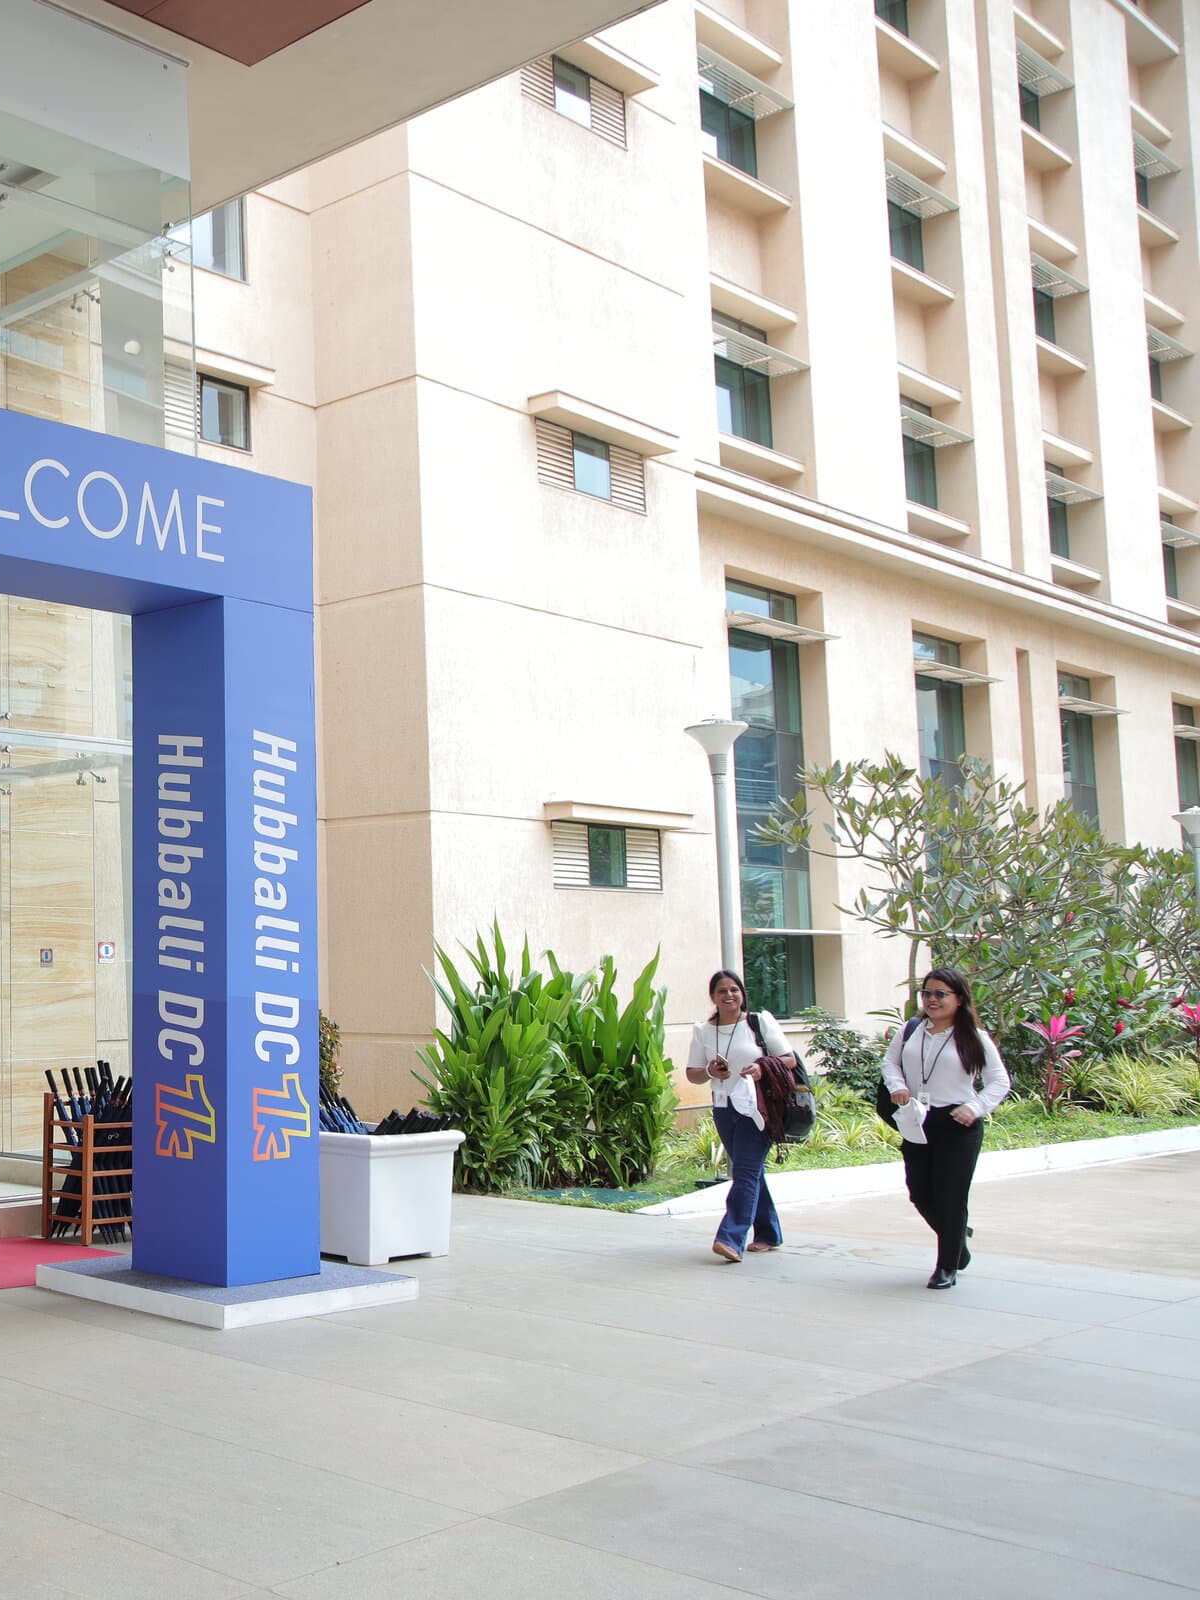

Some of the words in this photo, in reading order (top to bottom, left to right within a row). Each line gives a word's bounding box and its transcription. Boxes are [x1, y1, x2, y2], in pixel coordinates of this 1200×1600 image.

[158, 734, 204, 974] Hubballi
[253, 729, 300, 973] Hubballi
[158, 990, 205, 1066] DC
[255, 991, 300, 1065] DC
